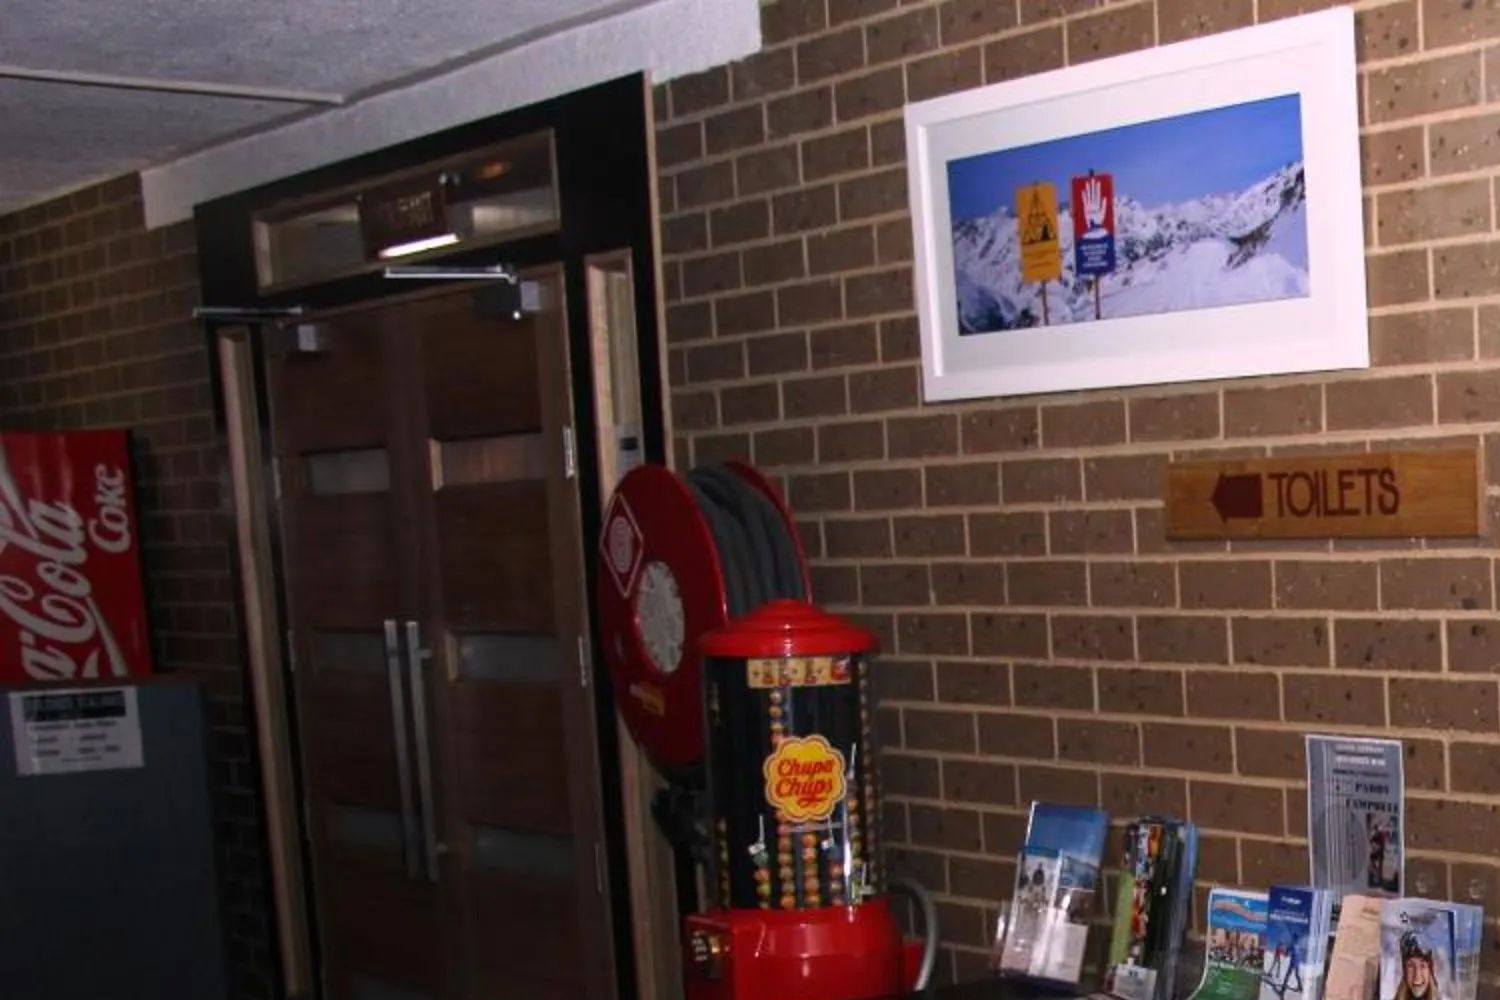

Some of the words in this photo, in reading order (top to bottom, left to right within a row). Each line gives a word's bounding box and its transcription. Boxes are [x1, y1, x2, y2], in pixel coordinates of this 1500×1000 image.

[88, 464, 131, 553] Coke
[1267, 467, 1399, 518] TOILETS
[777, 758, 835, 779] Chupa
[775, 778, 834, 800] Chups
